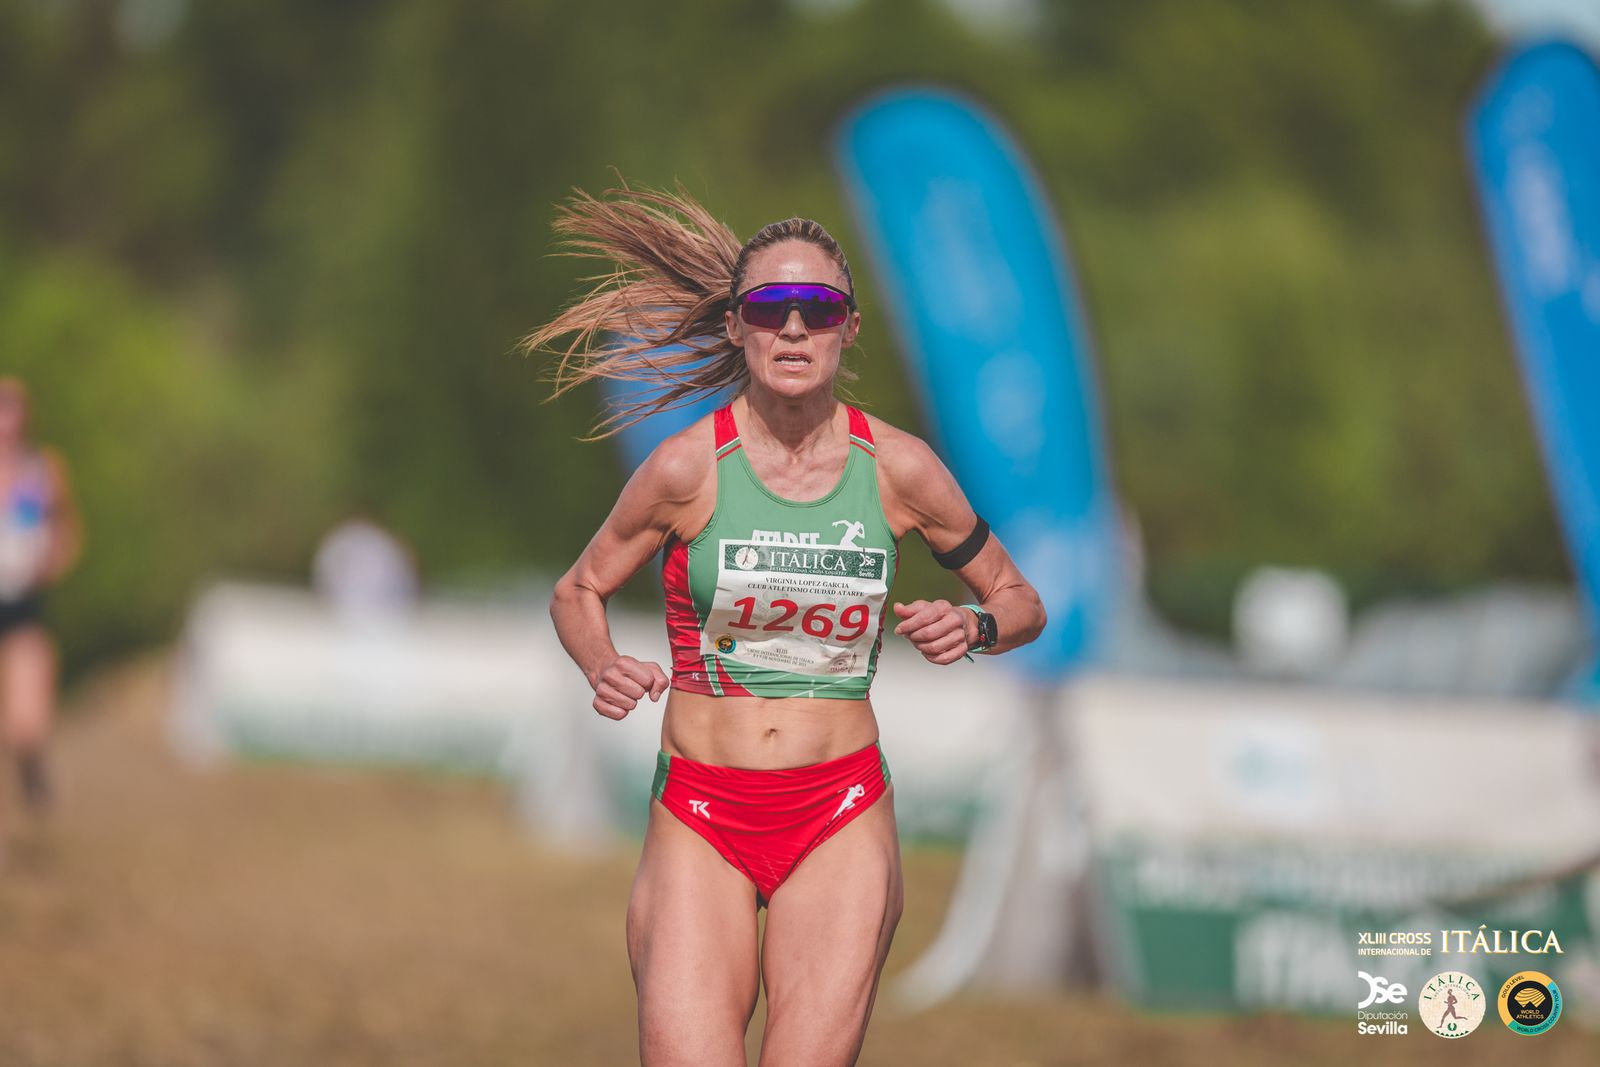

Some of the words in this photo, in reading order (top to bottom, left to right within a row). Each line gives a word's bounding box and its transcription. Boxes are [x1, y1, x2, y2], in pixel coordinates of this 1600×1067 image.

[770, 549, 847, 572] ITÁLICA
[765, 577, 797, 585] VIRGINIA
[822, 581, 849, 589] GARCIA
[768, 584, 808, 593] ATLETISMO
[727, 596, 870, 642] 1269
[688, 799, 711, 819] TK
